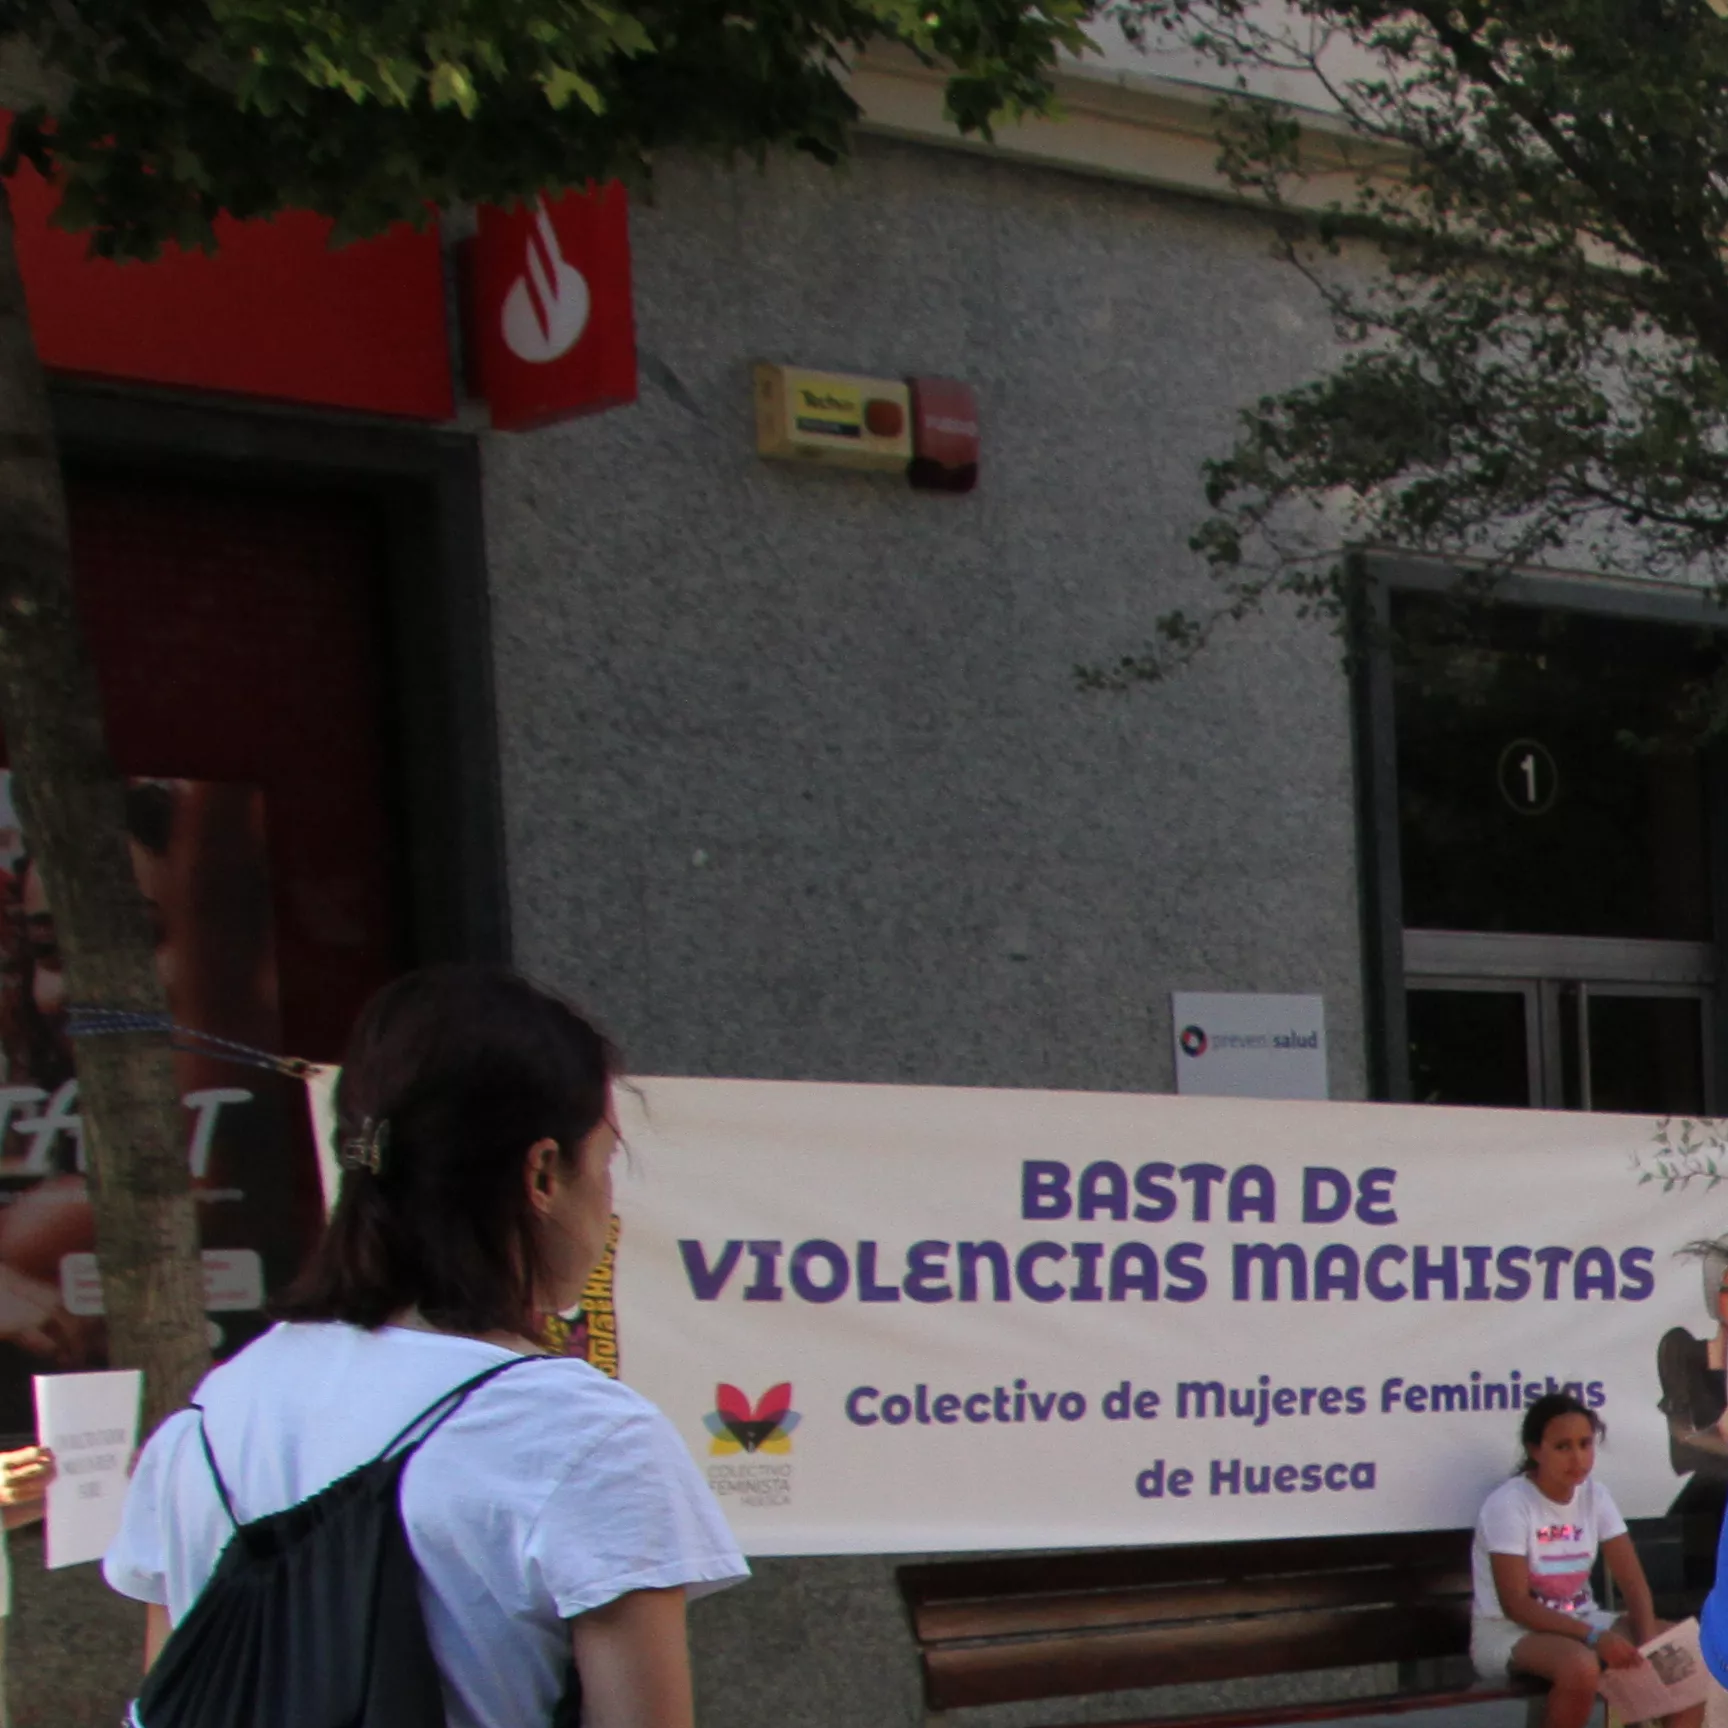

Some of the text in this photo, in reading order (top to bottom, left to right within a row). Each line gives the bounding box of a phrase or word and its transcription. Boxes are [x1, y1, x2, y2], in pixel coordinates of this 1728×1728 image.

[1519, 753, 1536, 803] 1
[1272, 1028, 1318, 1050] salud
[1021, 1159, 1399, 1226] BASTA DE
[676, 1237, 1209, 1304] VIOLENCIAS
[1231, 1242, 1656, 1303] MACHISTAS
[845, 1377, 1087, 1427] Colectivo
[1101, 1379, 1161, 1421] de
[1175, 1374, 1367, 1427] Mujeres
[1135, 1458, 1377, 1499] de Huesca
